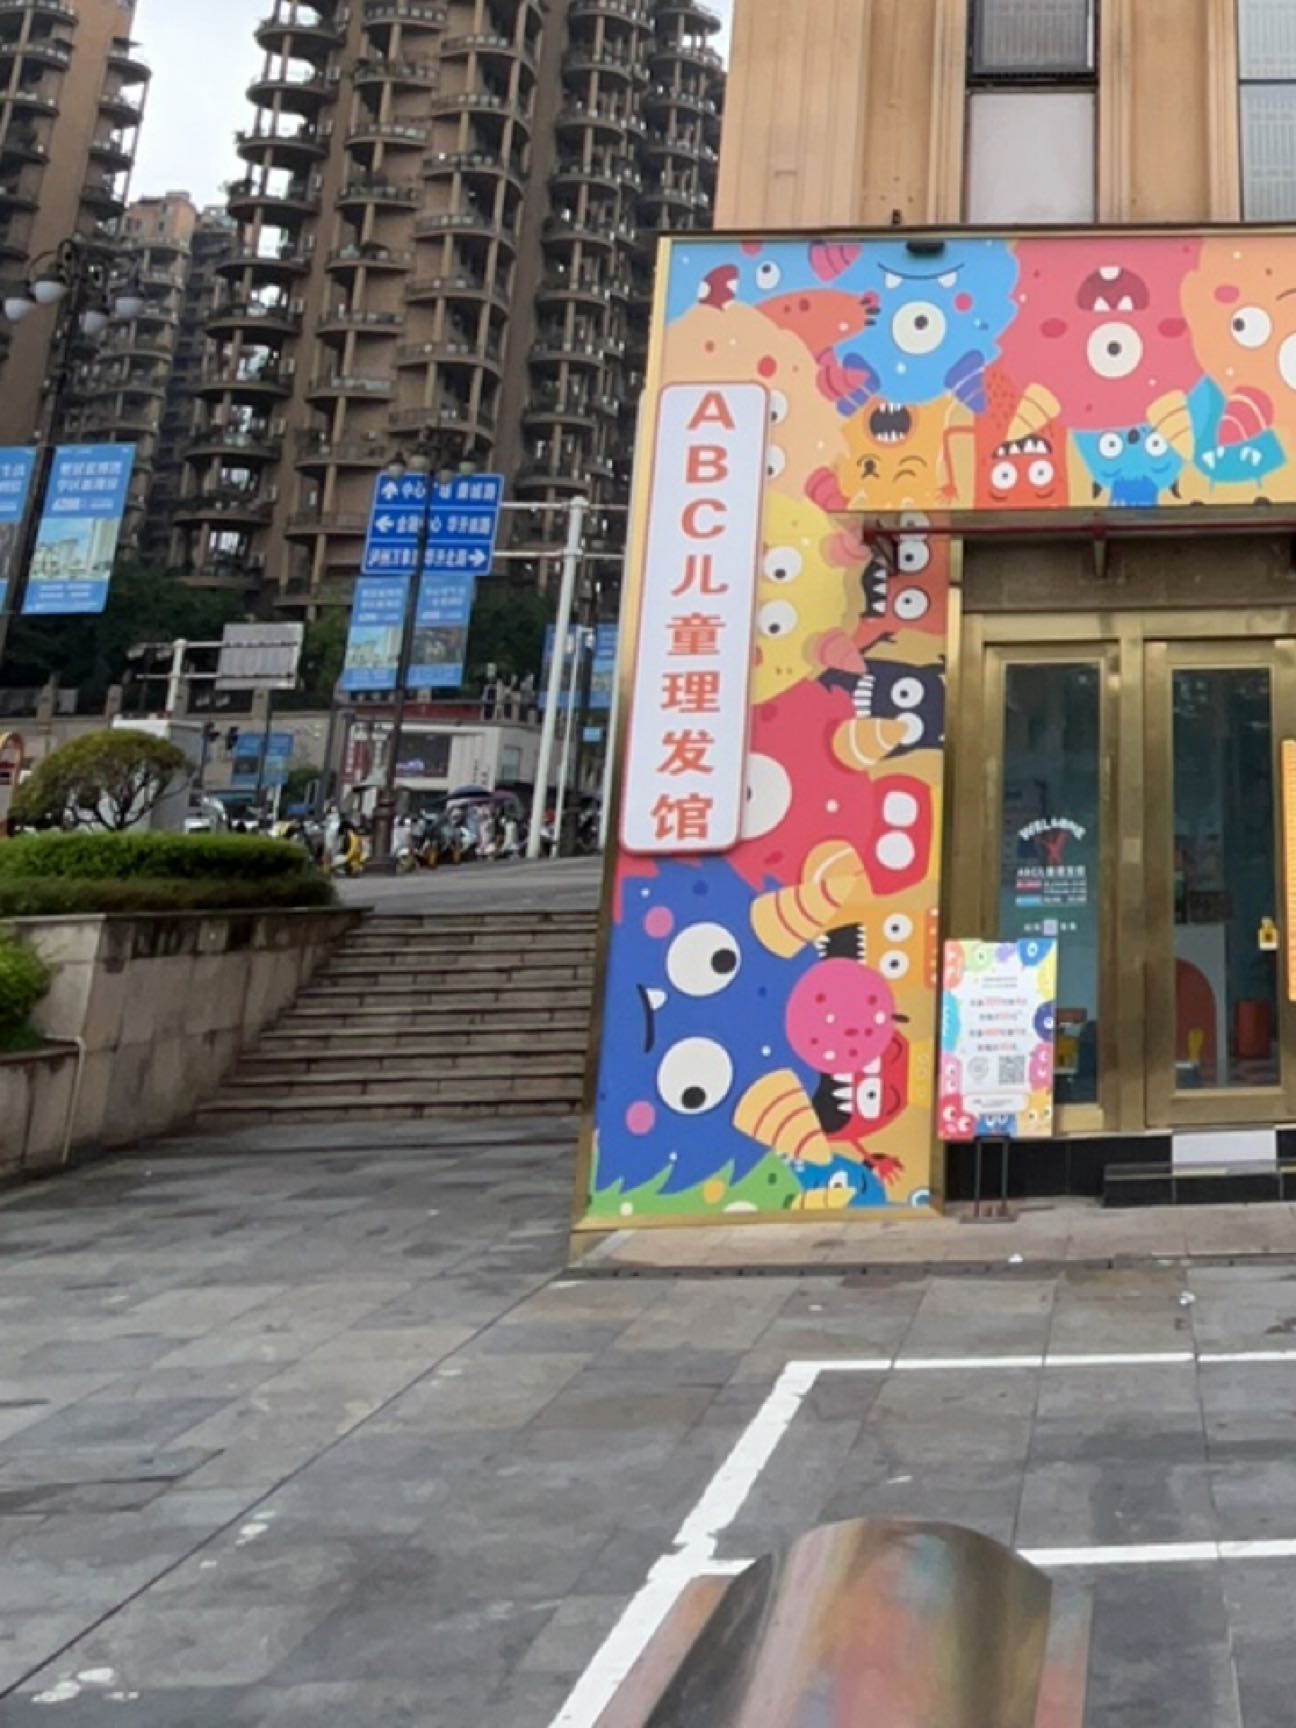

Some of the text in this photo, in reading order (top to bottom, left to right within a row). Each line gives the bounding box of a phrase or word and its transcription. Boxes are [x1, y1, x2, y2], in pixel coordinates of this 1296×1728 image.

[650, 390, 736, 842] ABC儿童理发馆
